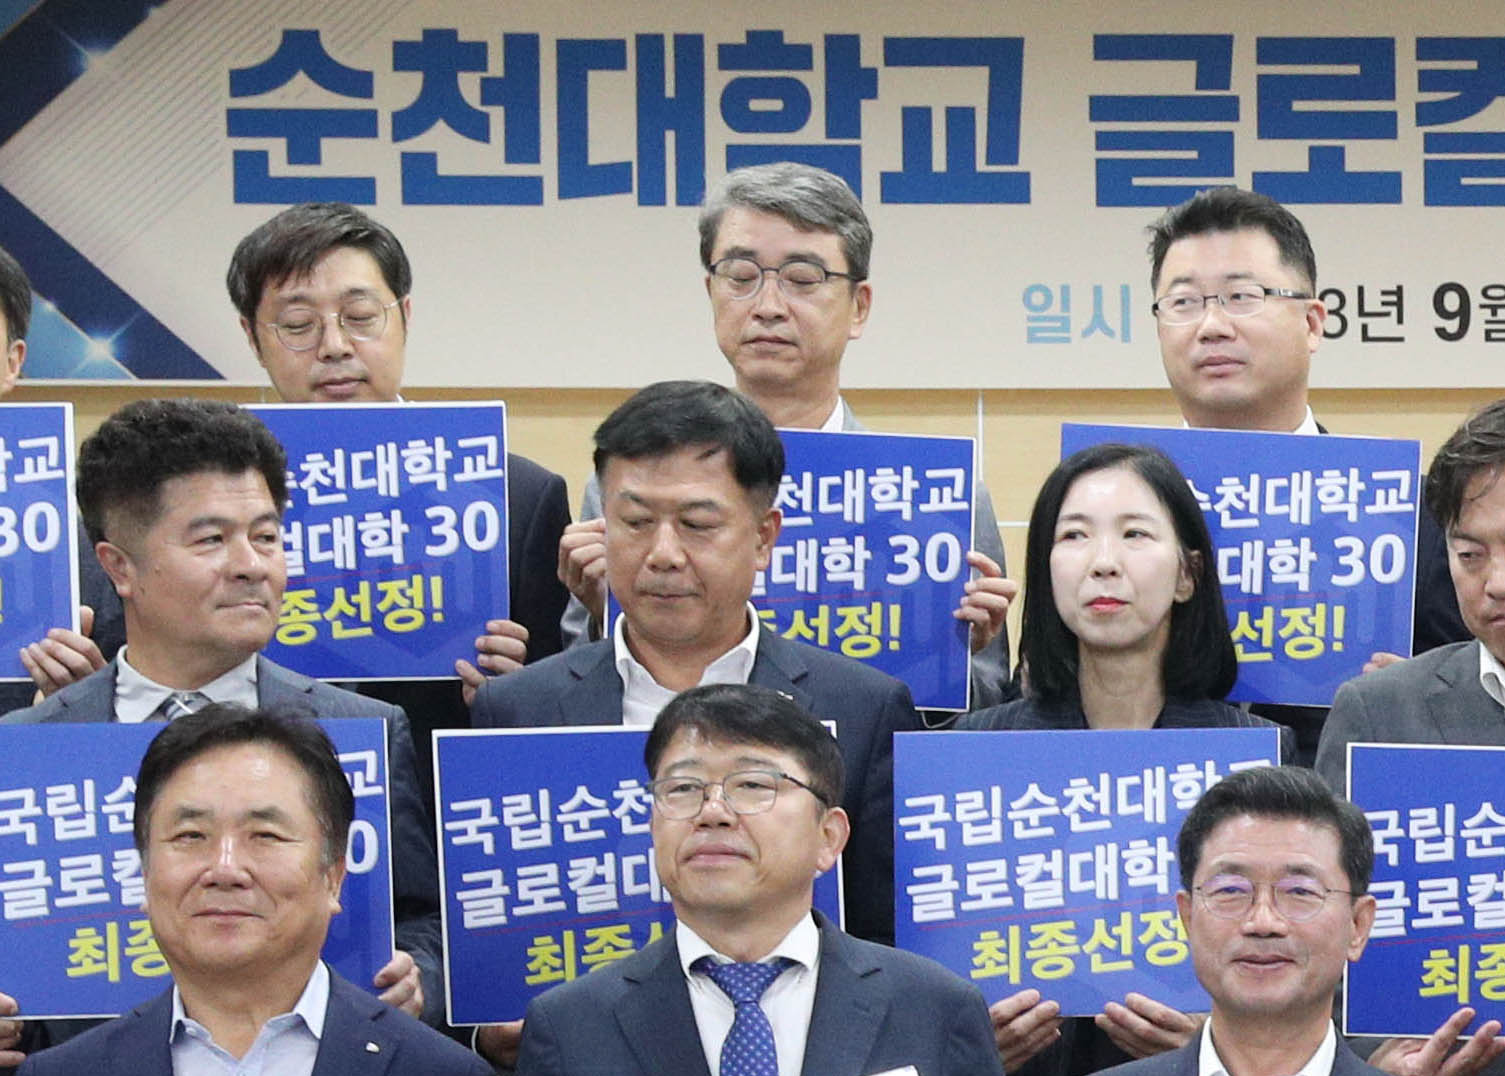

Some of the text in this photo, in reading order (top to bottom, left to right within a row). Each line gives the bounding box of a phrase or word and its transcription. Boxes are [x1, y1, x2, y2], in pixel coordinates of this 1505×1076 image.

[226, 27, 1032, 206] 순천대학교
[1022, 283, 1132, 344] 일시
[285, 436, 504, 508] 천대학교
[771, 466, 969, 526] 천대학교
[1186, 467, 1415, 528] 천대학교
[279, 500, 500, 577] 컬대학 30
[886, 532, 961, 586] 30
[1331, 534, 1406, 586] 30
[275, 574, 444, 645] 종선정!
[759, 602, 901, 658] 선정!
[1231, 603, 1346, 663] 선정!
[444, 779, 654, 856] 국립순천
[899, 759, 1271, 850] 국립순천대학
[0, 820, 378, 920] 글로컬 0
[456, 848, 673, 929] 글로컬대
[906, 836, 1175, 923] 글로컬대학
[970, 910, 1190, 985] 최종선정
